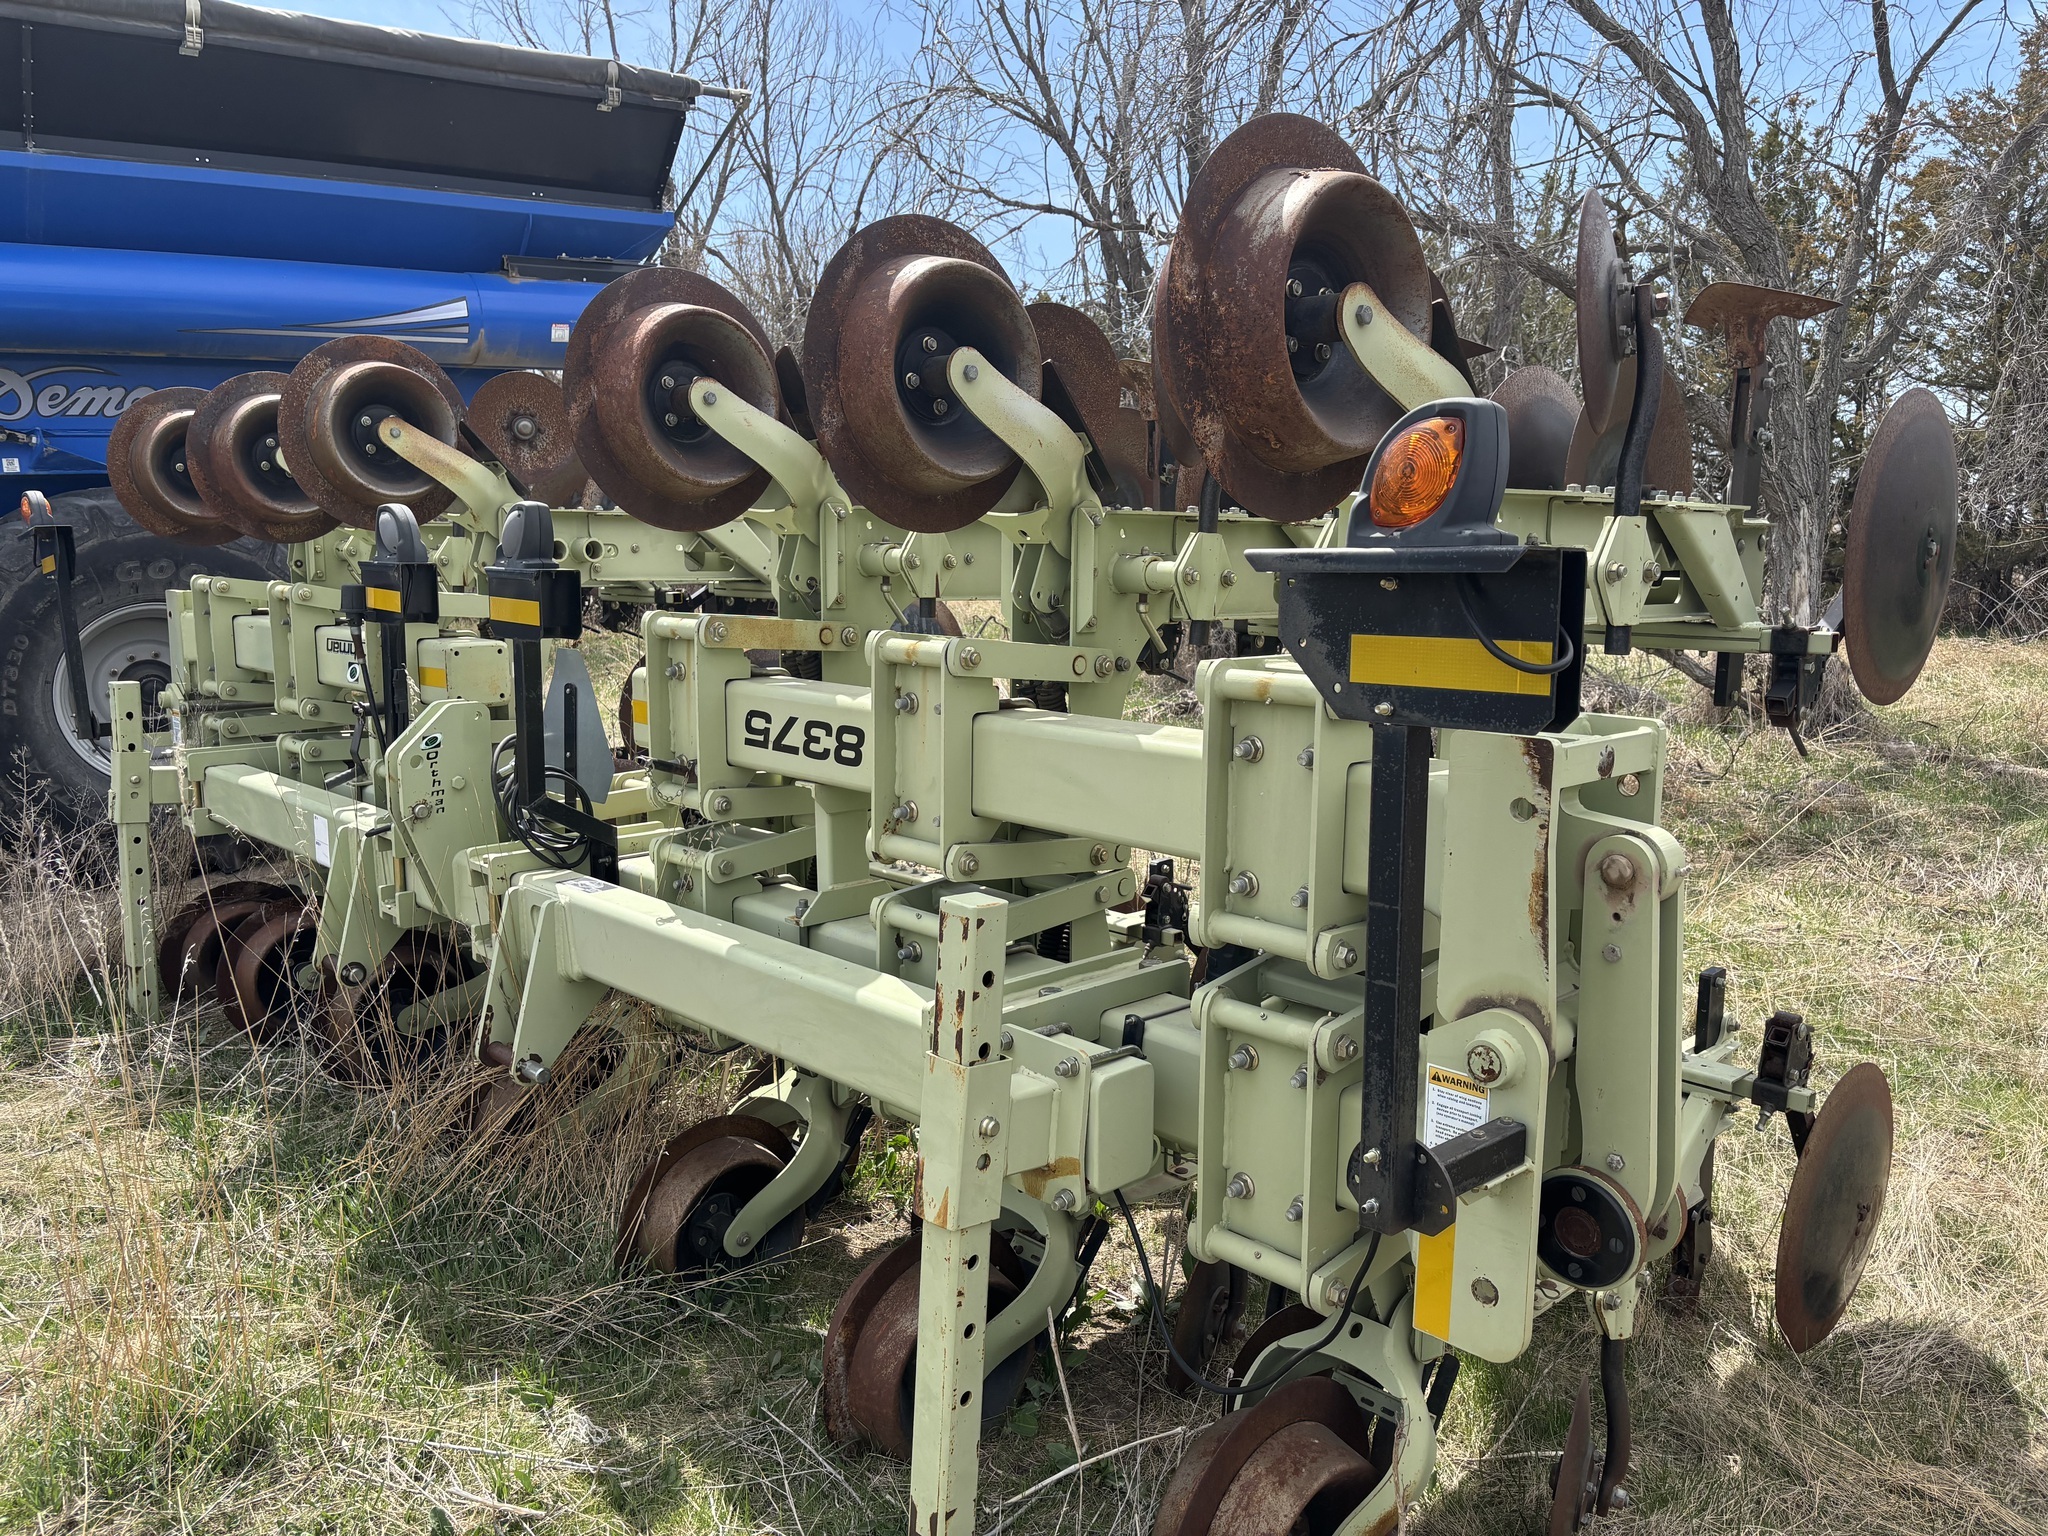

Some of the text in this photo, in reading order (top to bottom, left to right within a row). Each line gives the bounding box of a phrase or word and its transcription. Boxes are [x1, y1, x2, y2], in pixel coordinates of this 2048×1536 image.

[744, 709, 866, 768] 8375
[425, 750, 446, 814] Orthman
[1442, 1074, 1485, 1094] WARNING
